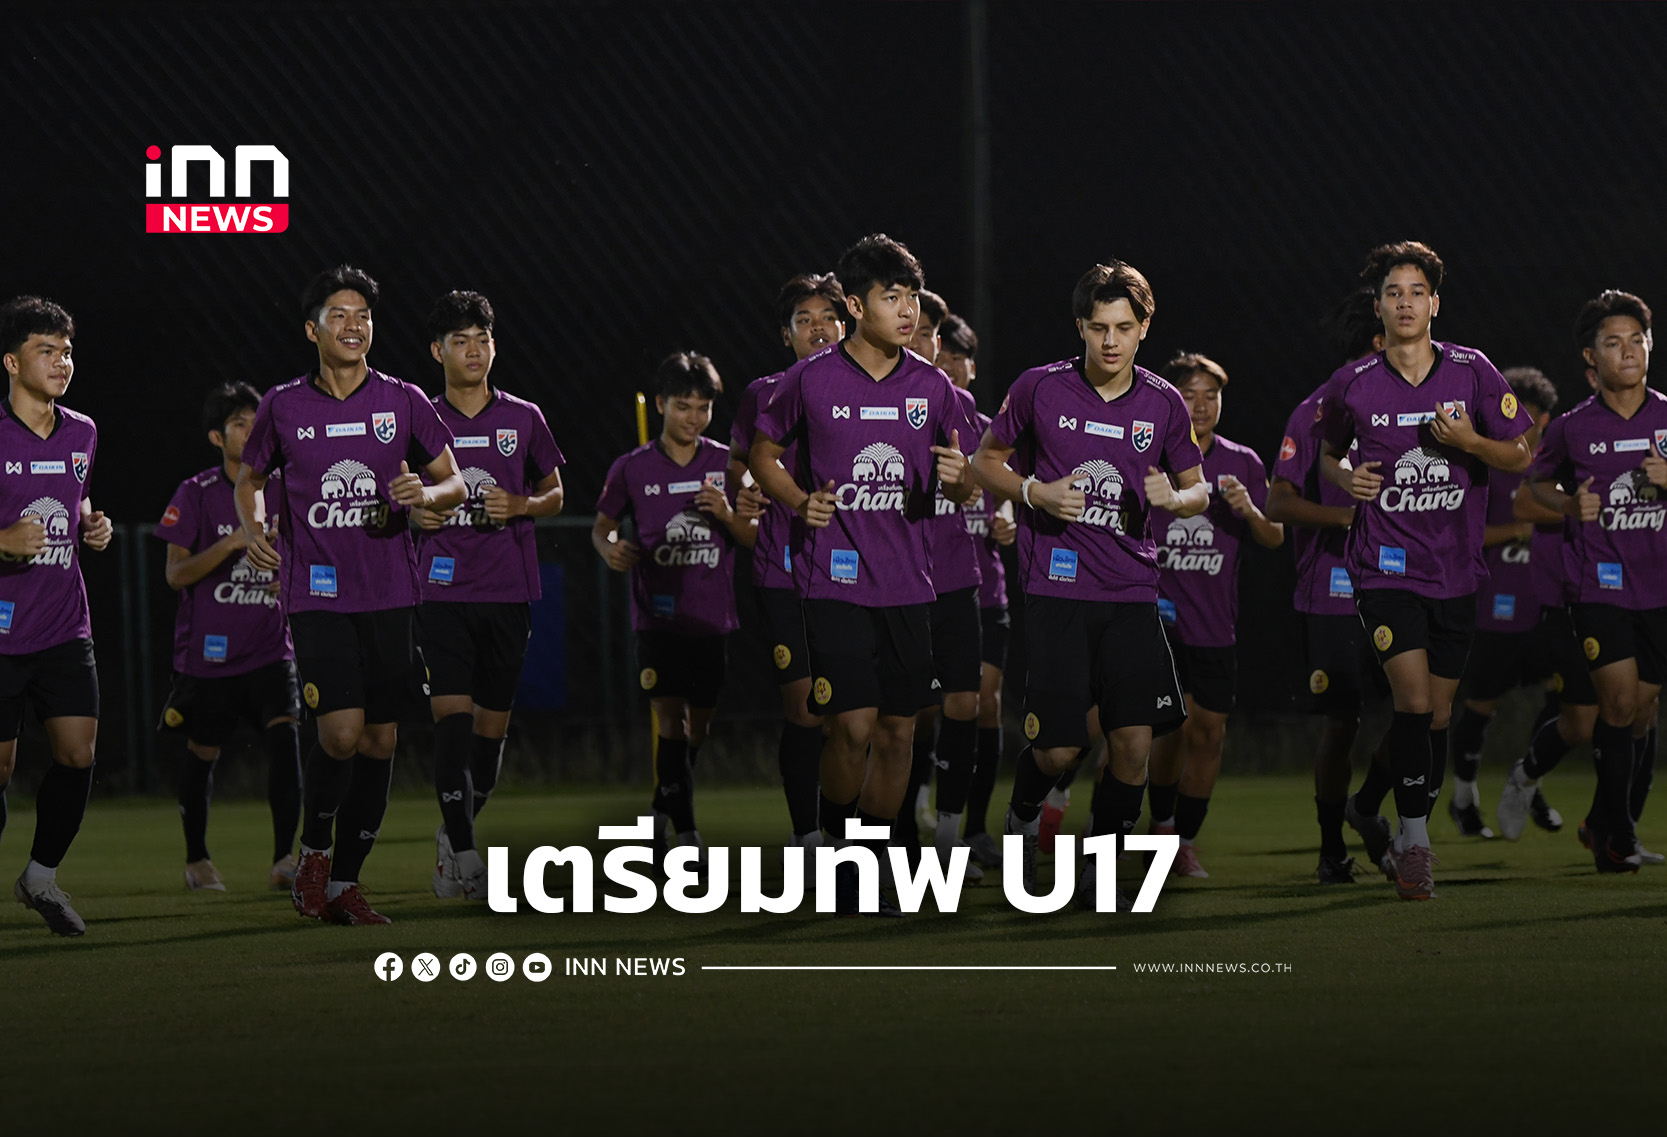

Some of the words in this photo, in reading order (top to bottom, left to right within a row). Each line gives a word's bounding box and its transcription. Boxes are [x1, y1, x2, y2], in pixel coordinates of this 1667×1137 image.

[334, 425, 364, 433] DAIKIN
[1093, 425, 1122, 436] DAIKIN
[1379, 486, 1465, 512] Chang
[1600, 507, 1667, 532] Chang
[654, 544, 721, 569] Chang
